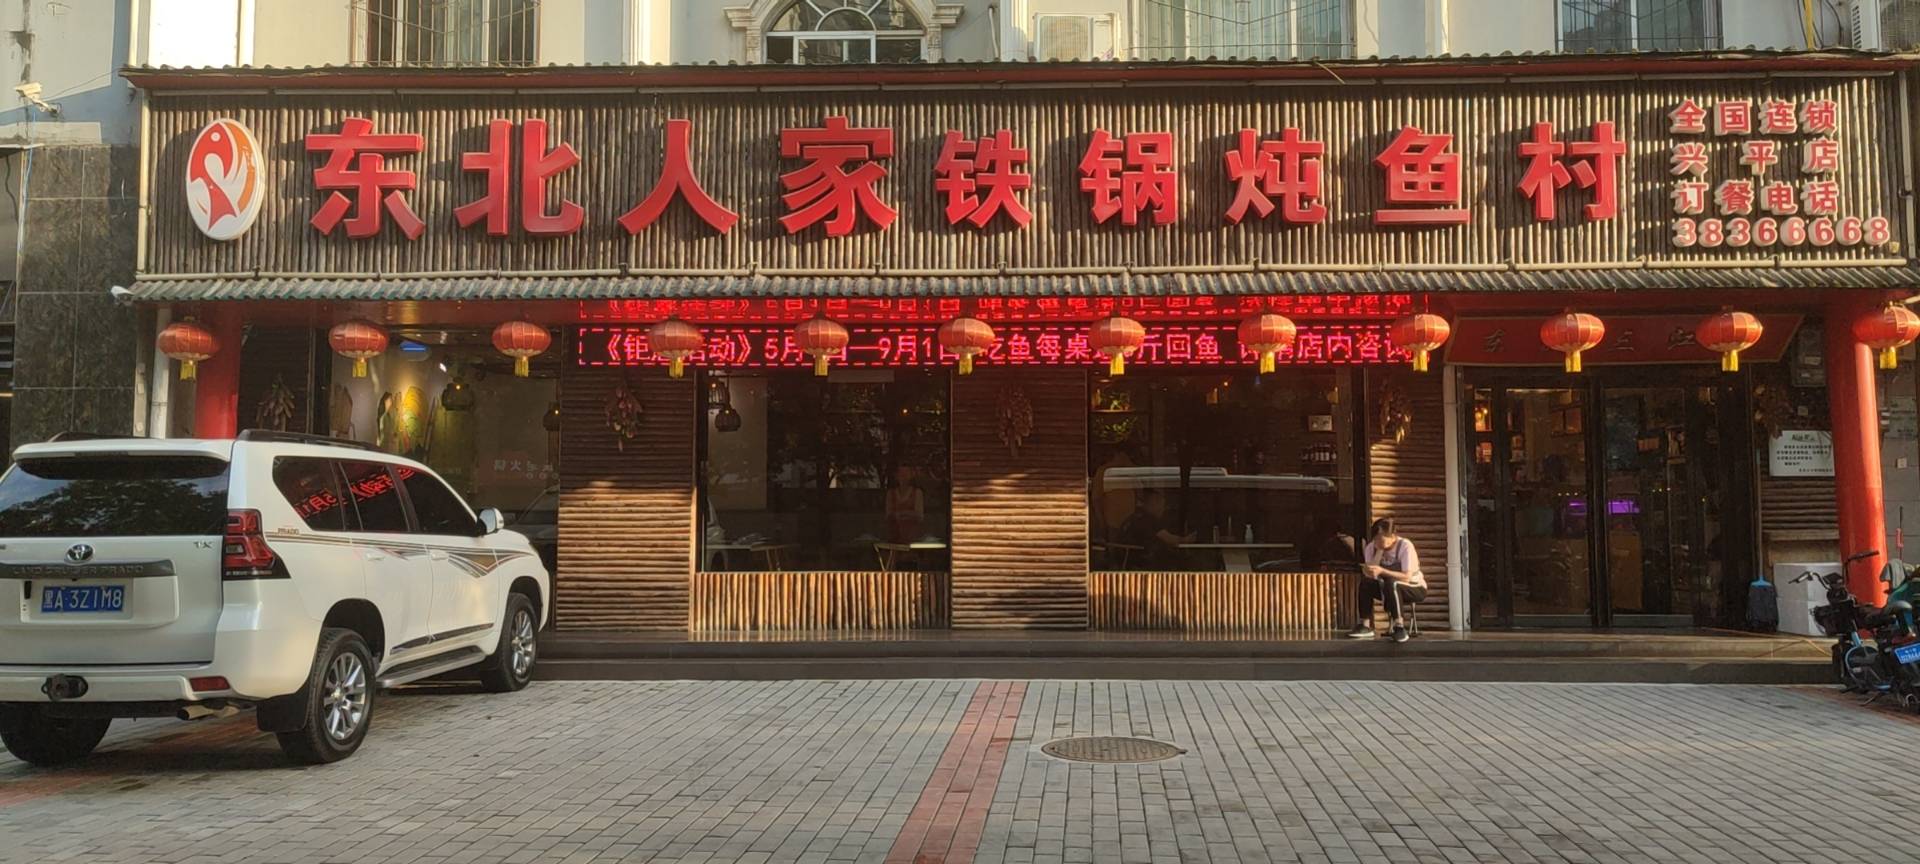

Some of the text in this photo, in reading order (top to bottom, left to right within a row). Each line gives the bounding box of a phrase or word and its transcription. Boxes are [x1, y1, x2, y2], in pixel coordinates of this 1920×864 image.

[1669, 100, 1838, 135] 全国连锁
[1670, 138, 1839, 175] 兴平店
[305, 115, 1627, 239] 东北人家铁锅炖鱼村
[1671, 180, 1839, 215] 订餐电话
[1672, 217, 1890, 247] 38366668
